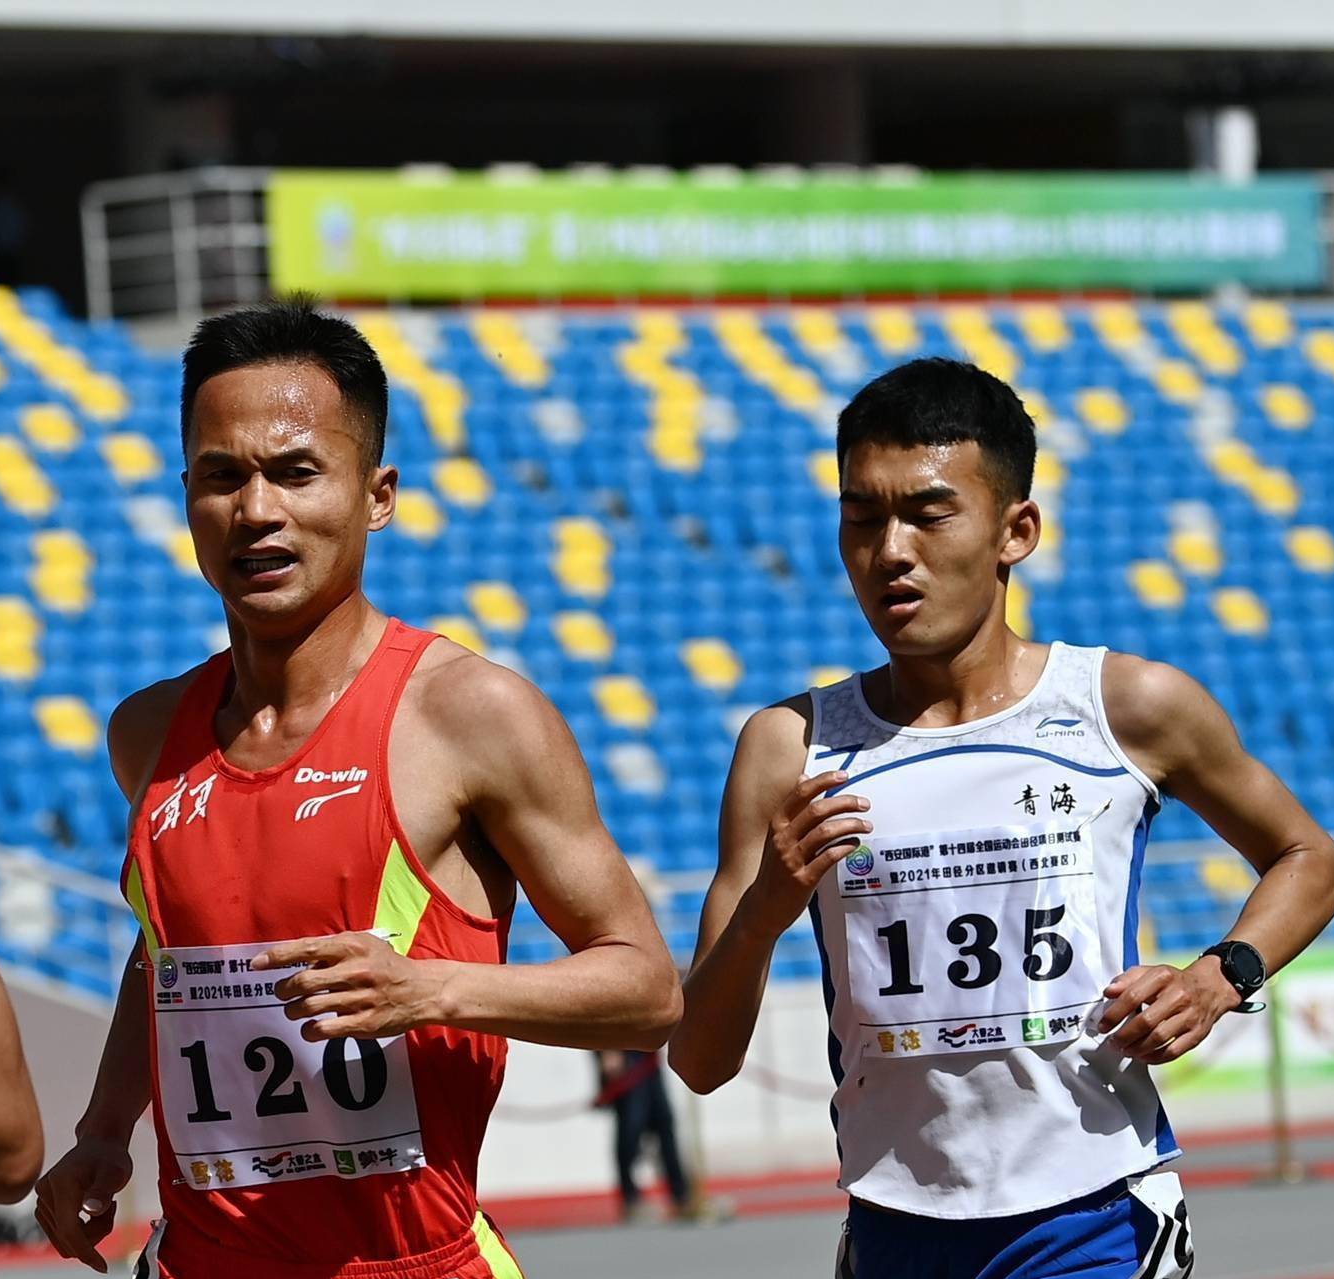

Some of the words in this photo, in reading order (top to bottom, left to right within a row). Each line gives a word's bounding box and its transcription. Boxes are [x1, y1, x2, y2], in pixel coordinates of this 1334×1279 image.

[1036, 729, 1085, 738] LI-NING
[294, 766, 368, 784] Do-win
[1014, 784, 1077, 815] 青海
[878, 904, 1074, 997] 135
[180, 1037, 388, 1124] 120
